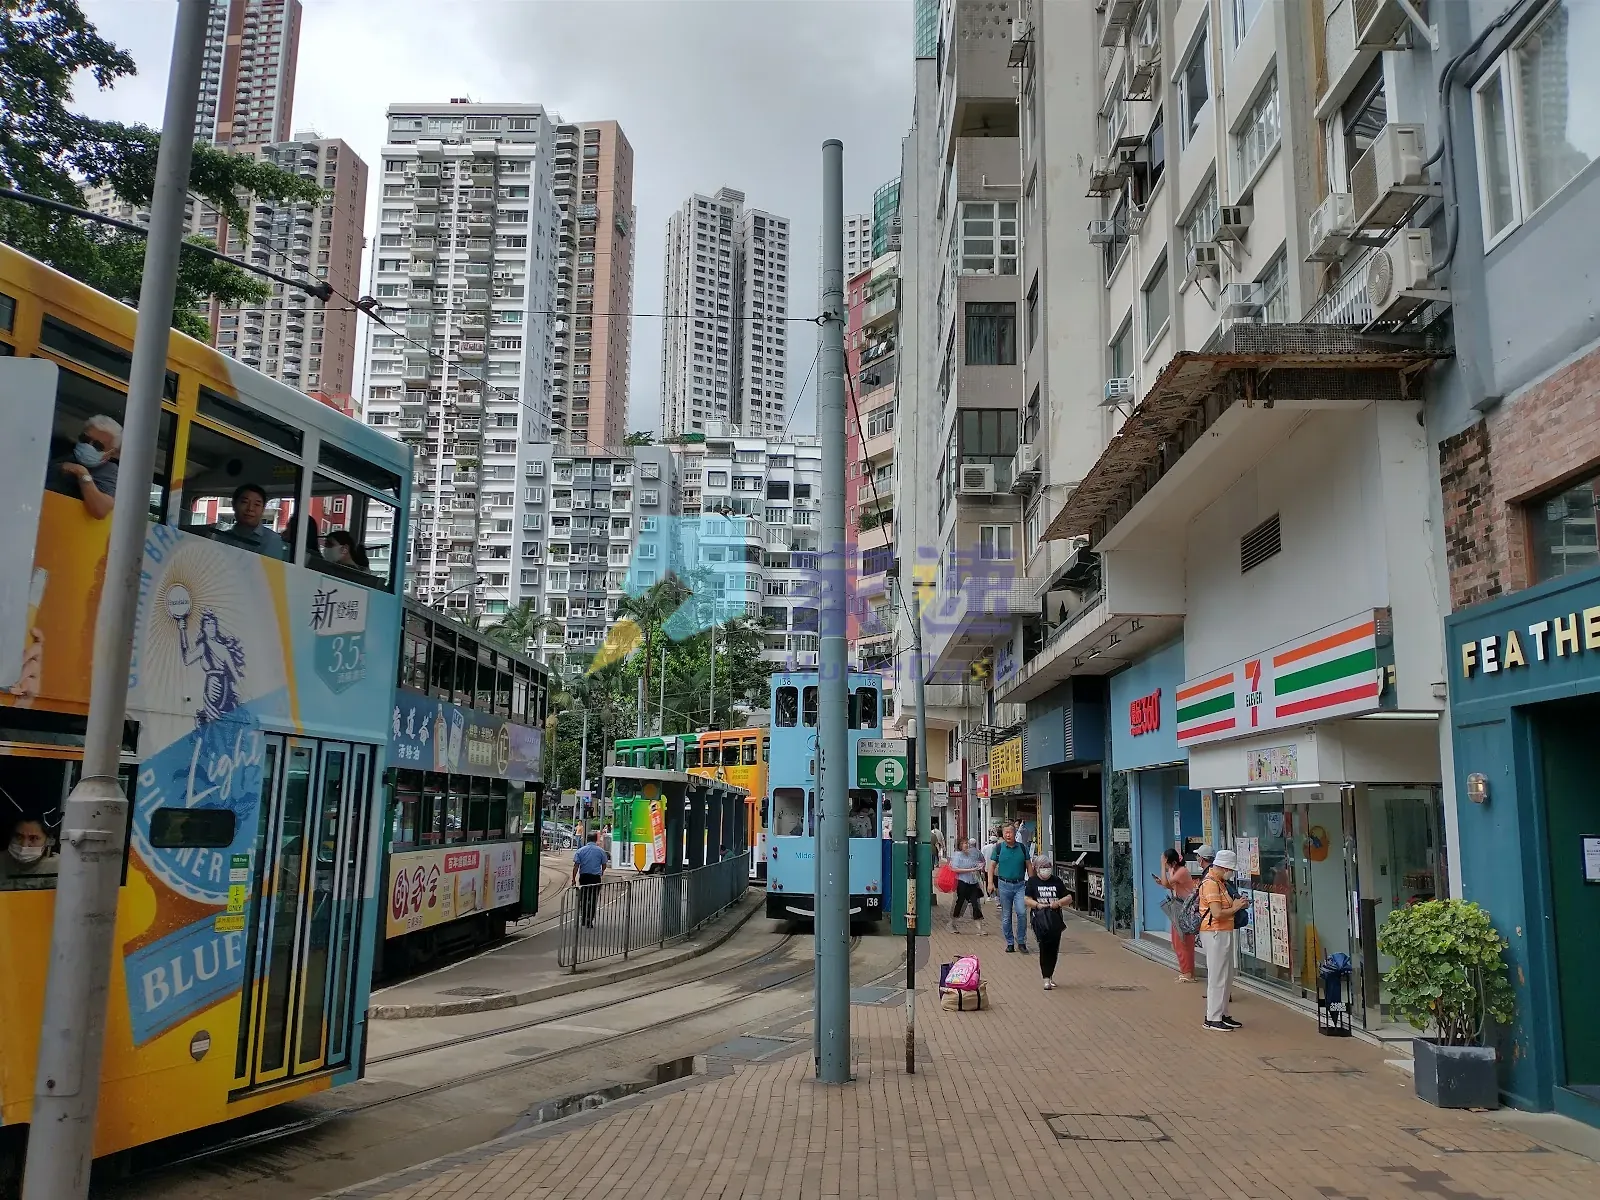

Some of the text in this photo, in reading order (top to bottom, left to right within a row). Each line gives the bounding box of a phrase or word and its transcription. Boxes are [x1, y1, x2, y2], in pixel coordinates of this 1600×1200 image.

[308, 588, 359, 631] 新登場
[778, 678, 792, 686] 138
[864, 678, 876, 687] 138
[186, 728, 263, 808] Light
[138, 767, 224, 883] PILNER
[866, 898, 879, 907] 138
[141, 933, 243, 1012] BLUE
